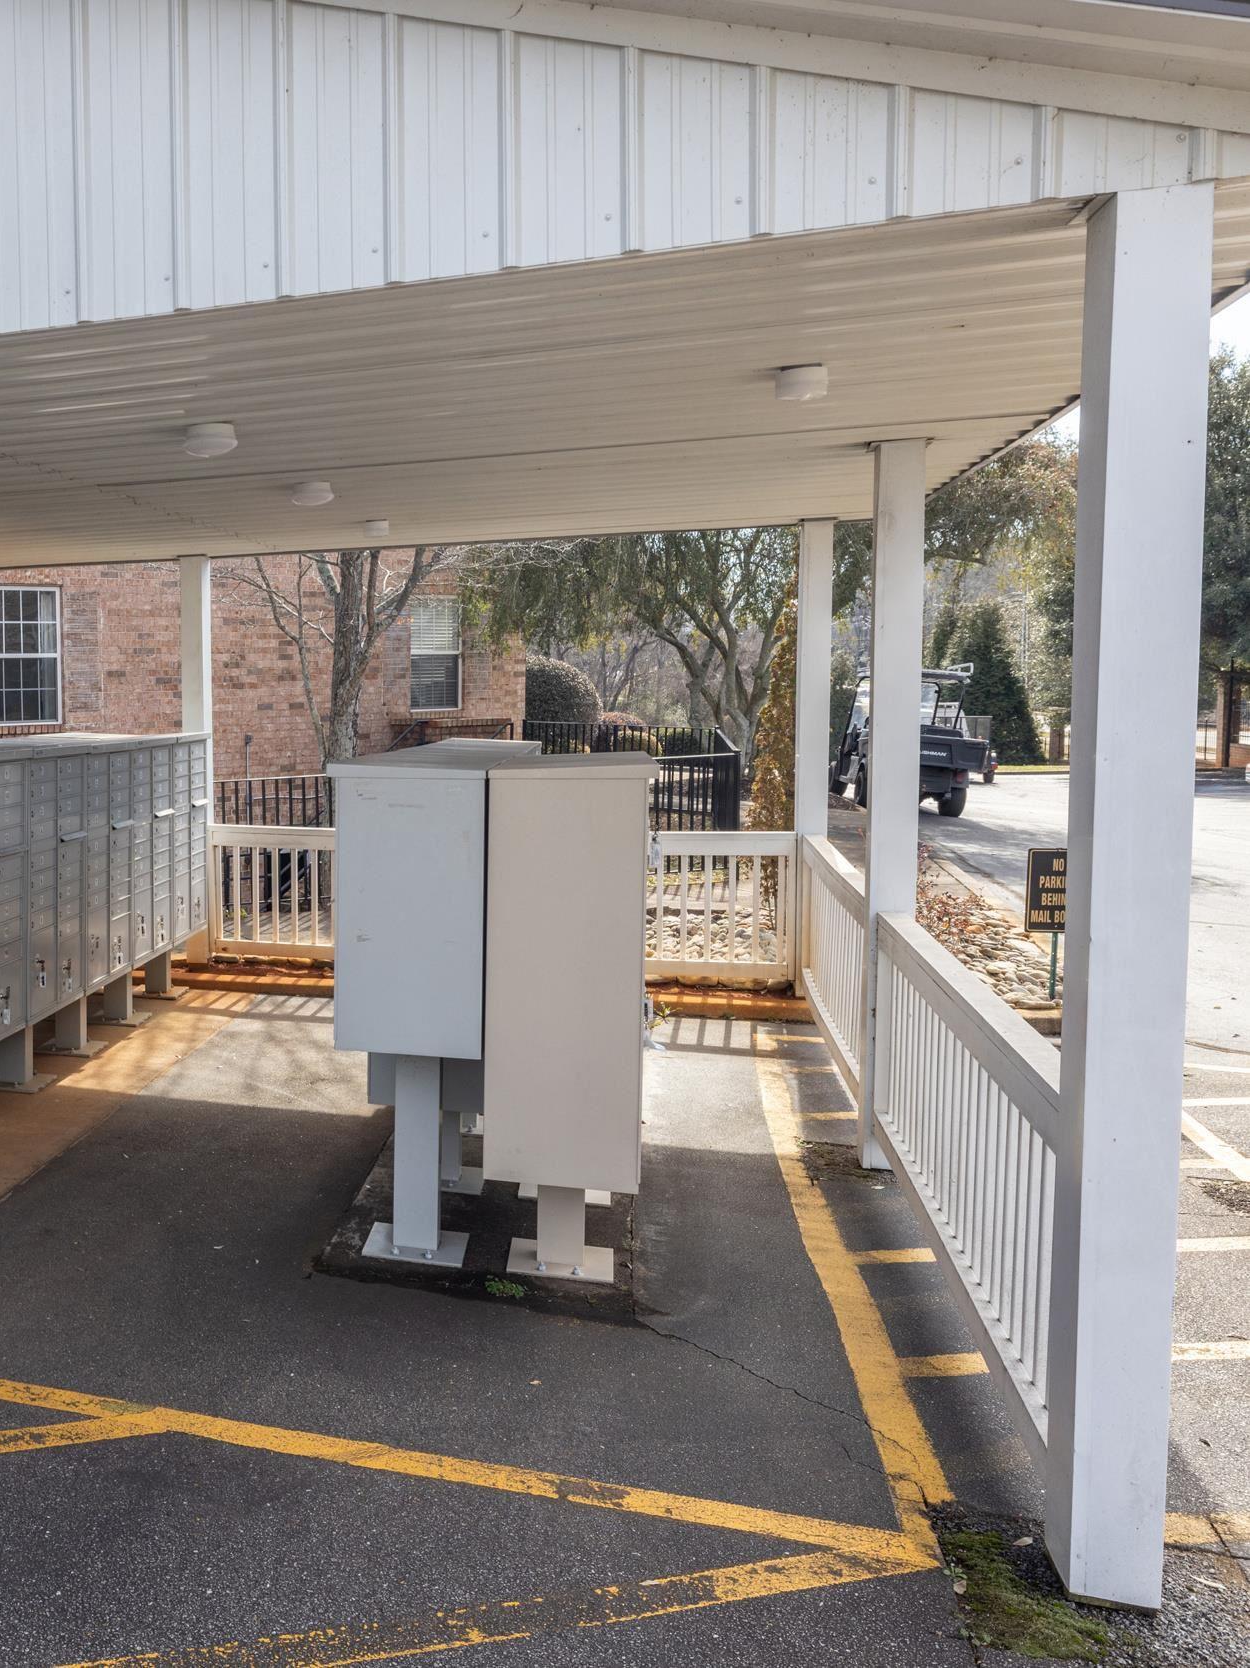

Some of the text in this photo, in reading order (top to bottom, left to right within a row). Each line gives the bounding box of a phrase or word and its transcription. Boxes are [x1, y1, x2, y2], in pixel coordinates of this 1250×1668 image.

[1052, 858, 1064, 871] NO
[1039, 875, 1067, 889] PARKI
[1041, 893, 1067, 906] BEHIN
[1030, 910, 1051, 923] MAIL
